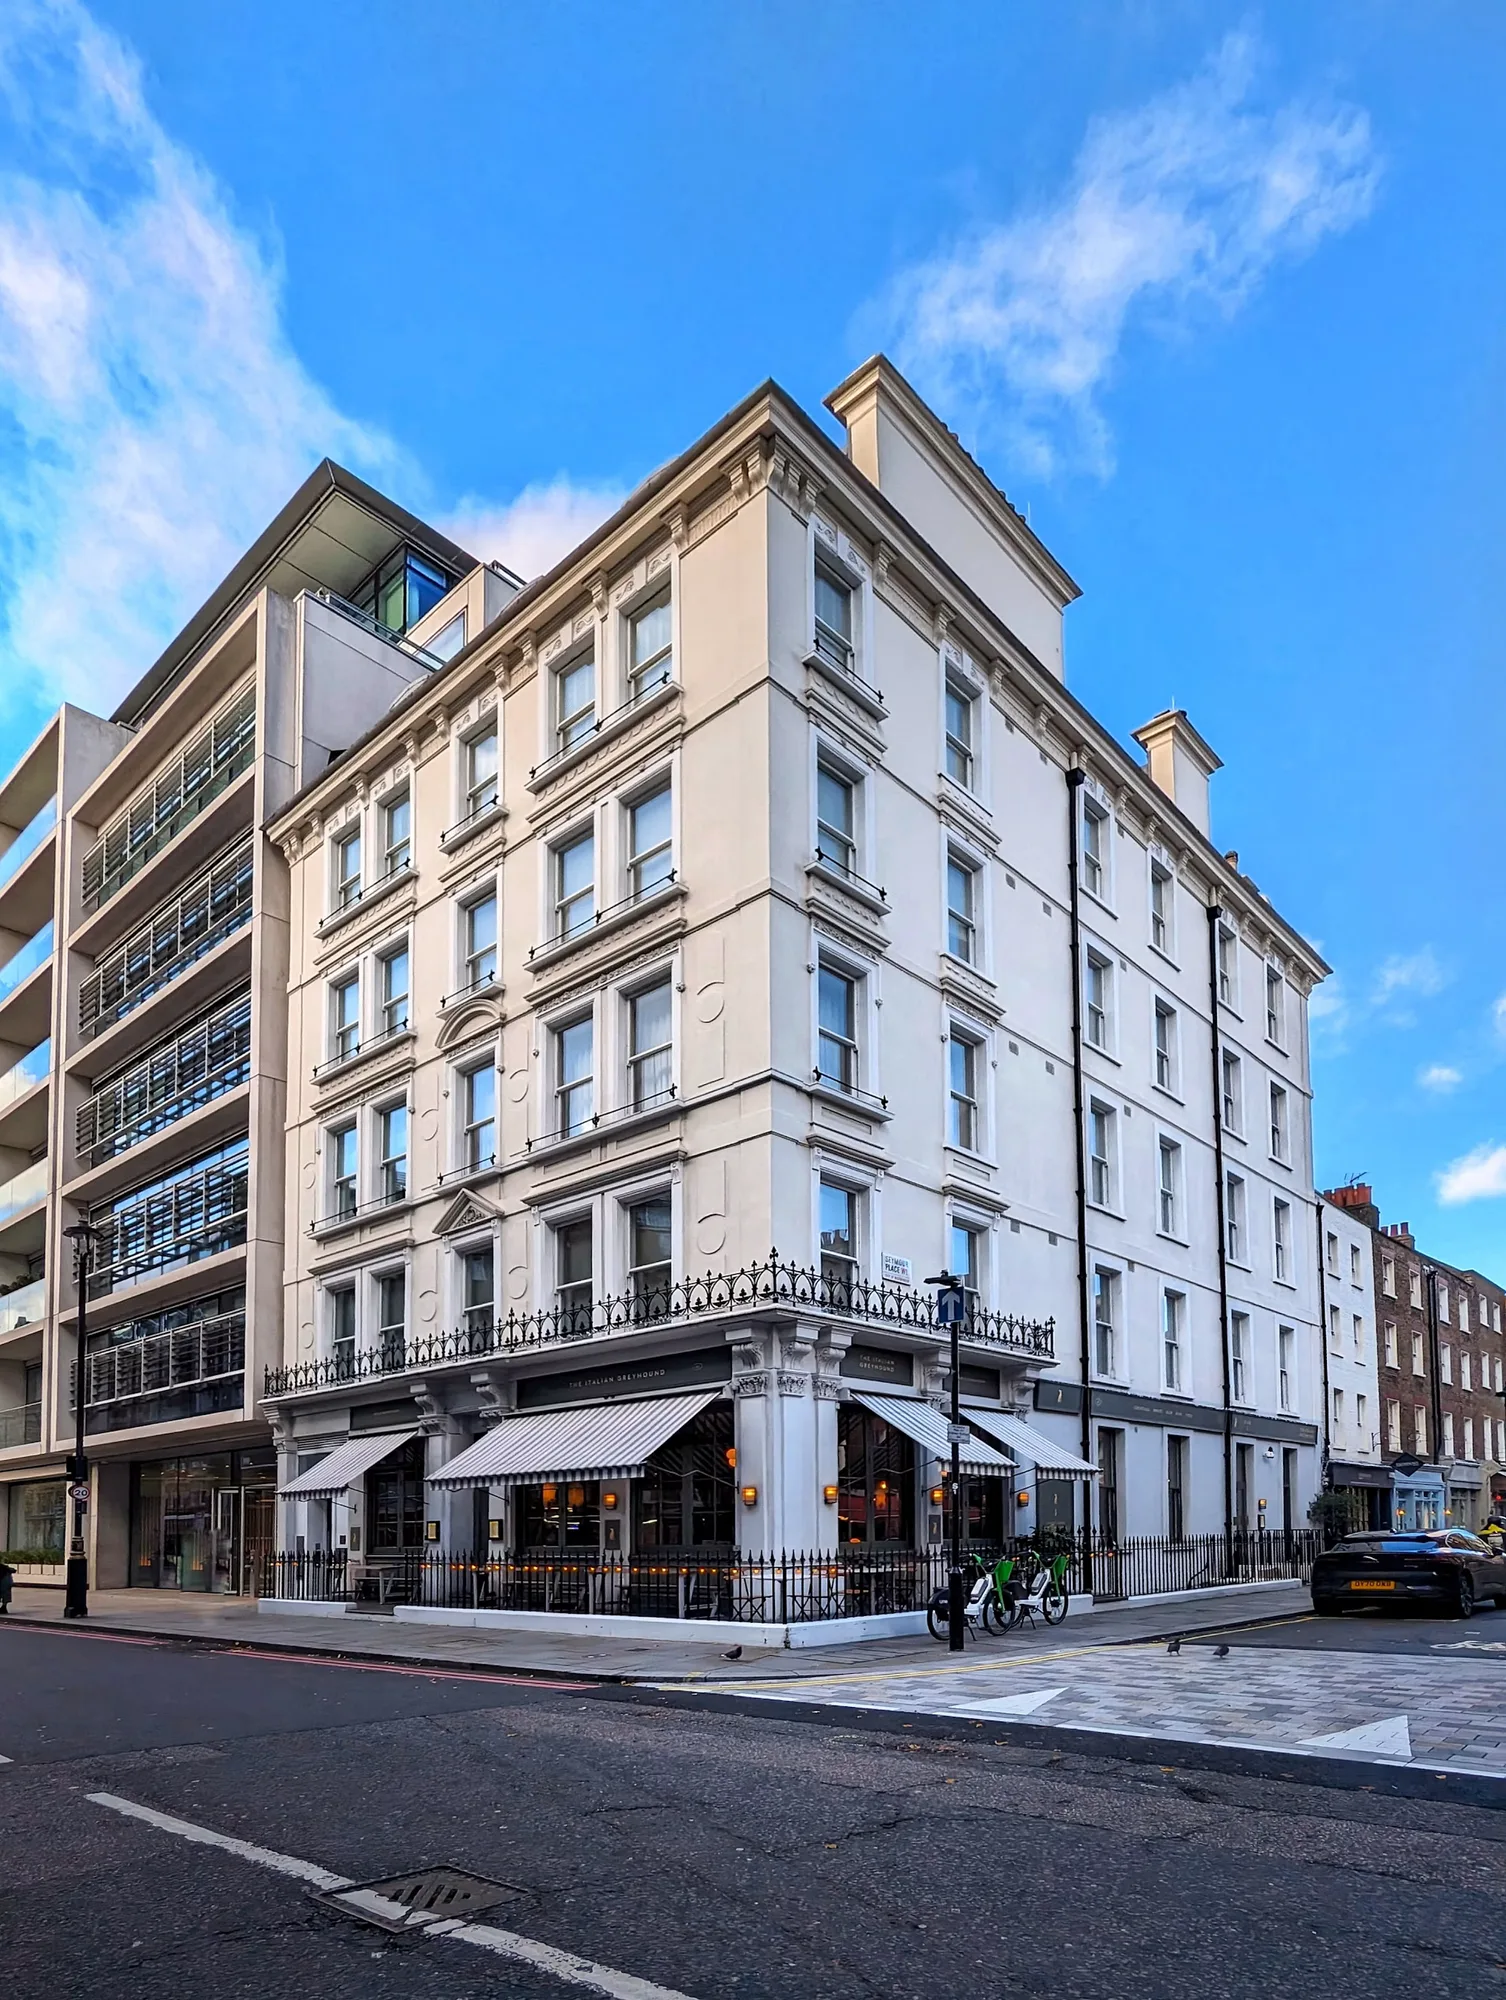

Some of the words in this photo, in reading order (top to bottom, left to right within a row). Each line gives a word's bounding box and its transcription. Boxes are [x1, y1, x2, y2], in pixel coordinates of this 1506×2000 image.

[885, 1256, 908, 1267] SEYMOUR
[885, 1264, 900, 1273] PLACE
[859, 1362, 895, 1372] GREYHOUND
[584, 1377, 614, 1386] ITALIAN
[617, 1369, 665, 1381] GREYHOUND
